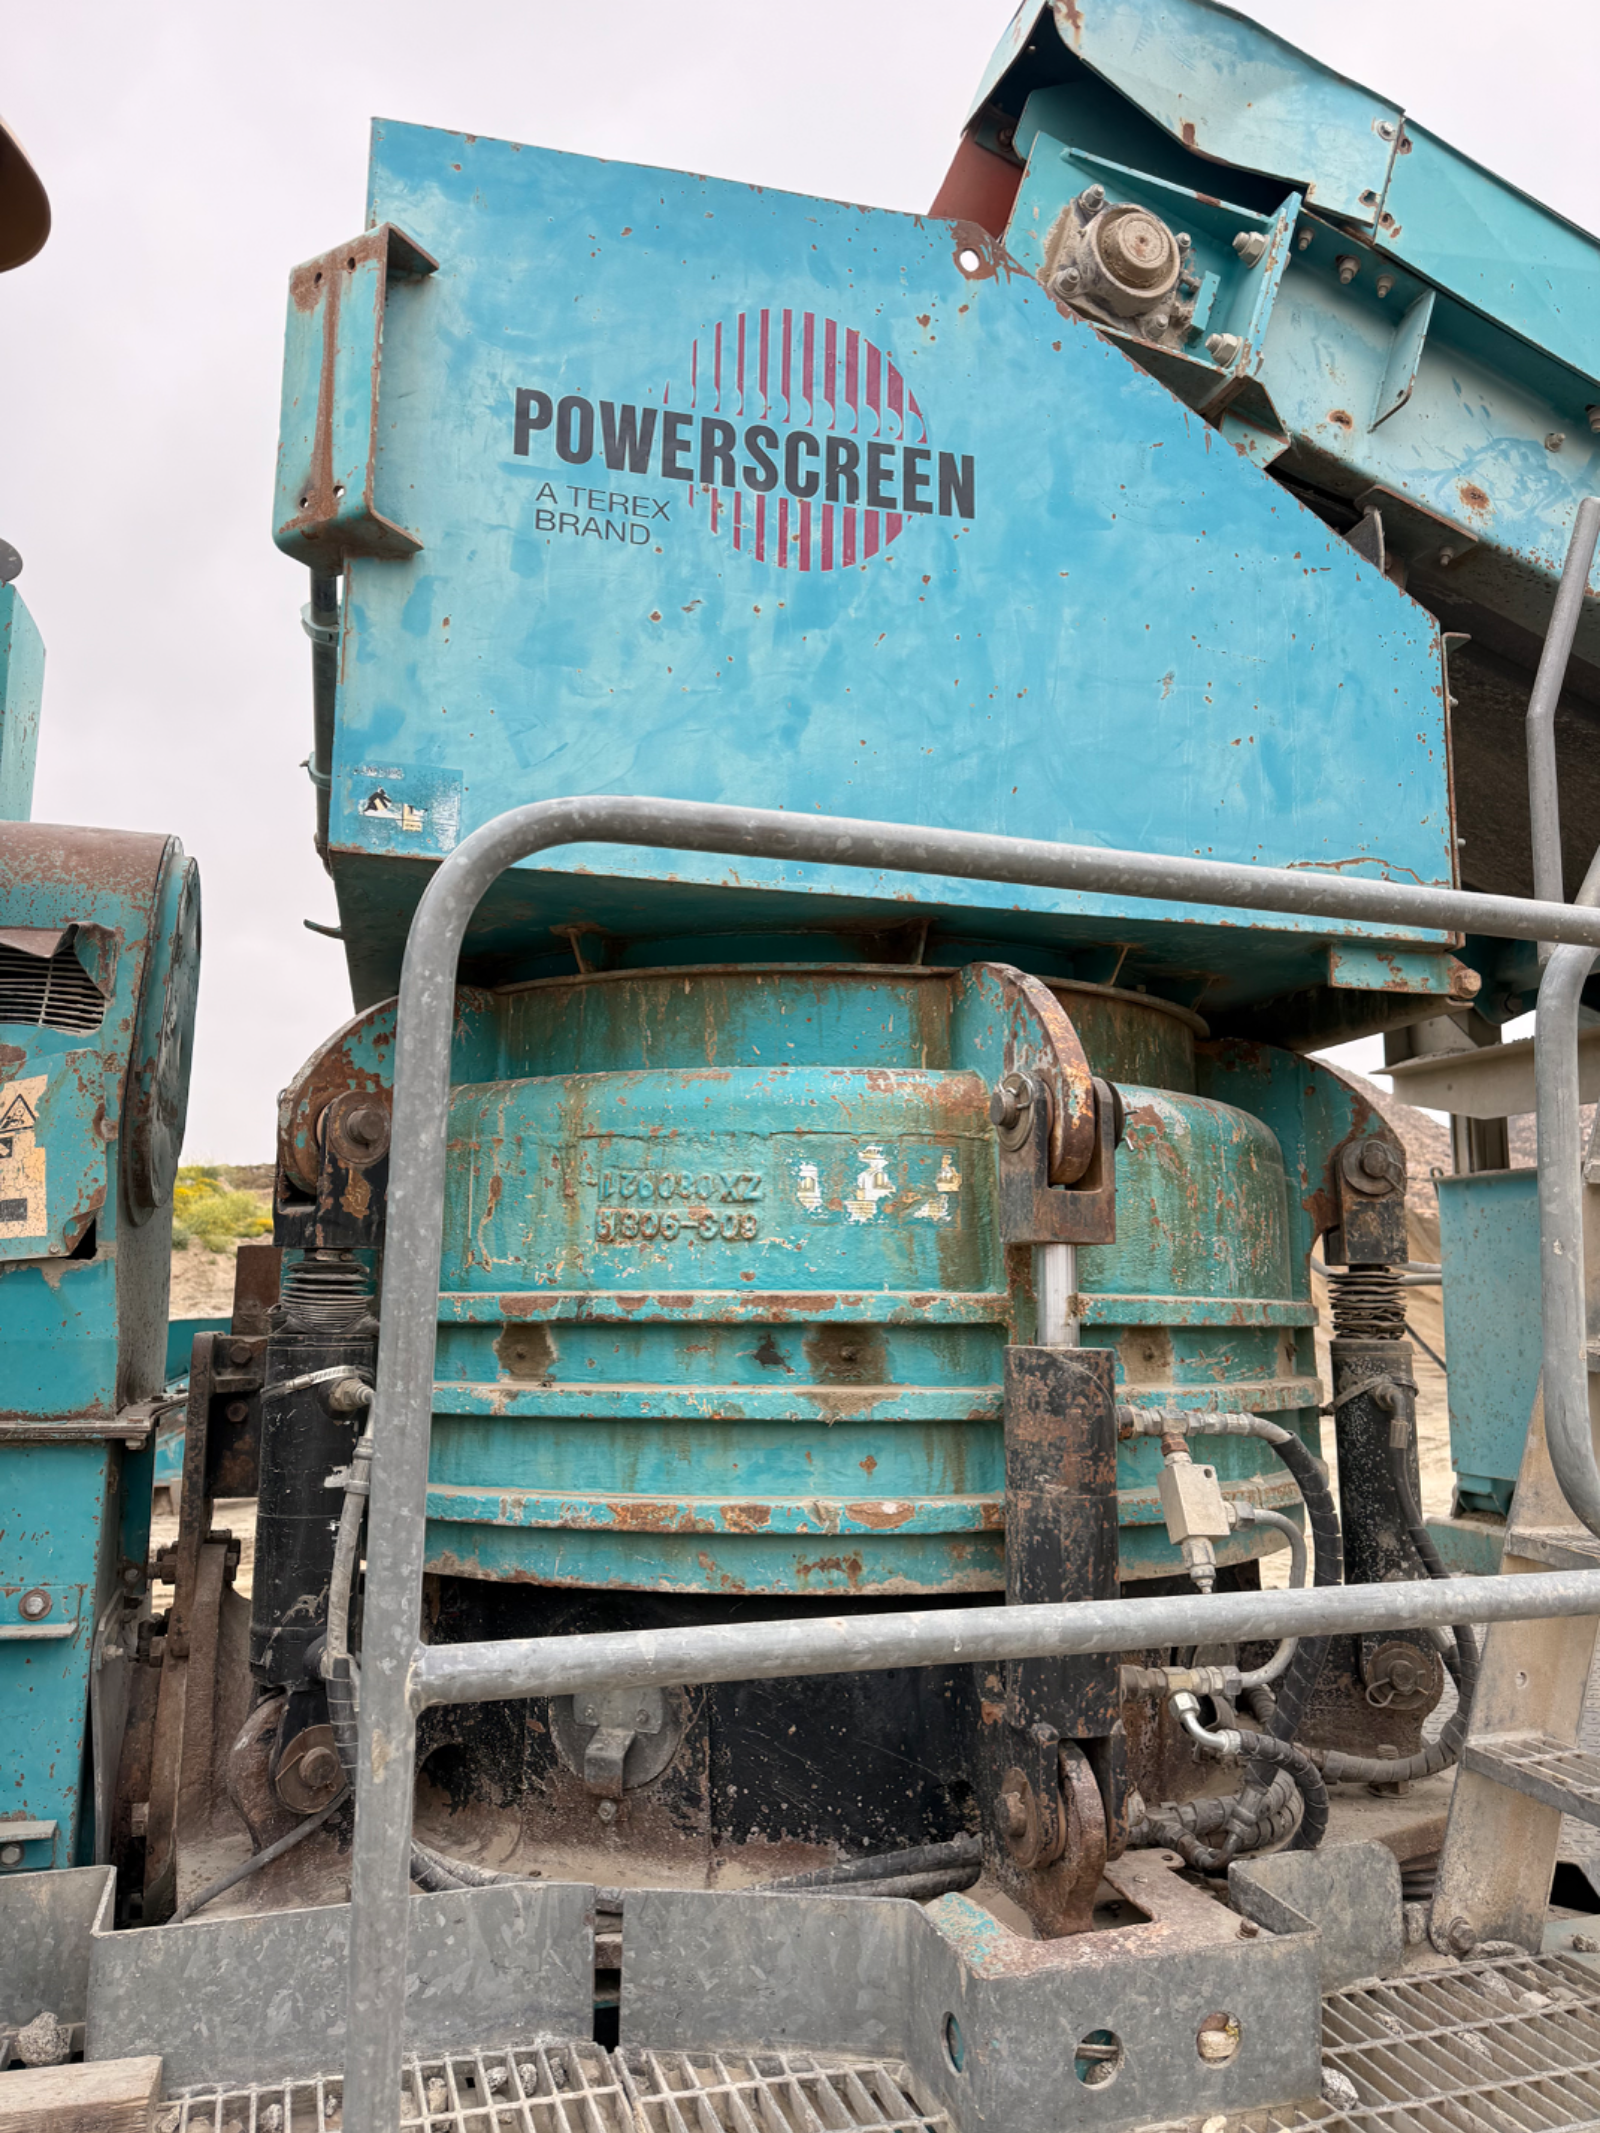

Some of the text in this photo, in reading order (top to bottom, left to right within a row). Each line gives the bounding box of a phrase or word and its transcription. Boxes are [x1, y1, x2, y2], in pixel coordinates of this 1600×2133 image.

[514, 387, 976, 519] POWERSCREEN
[535, 482, 671, 522] A TEREX
[535, 509, 651, 546] BRAND
